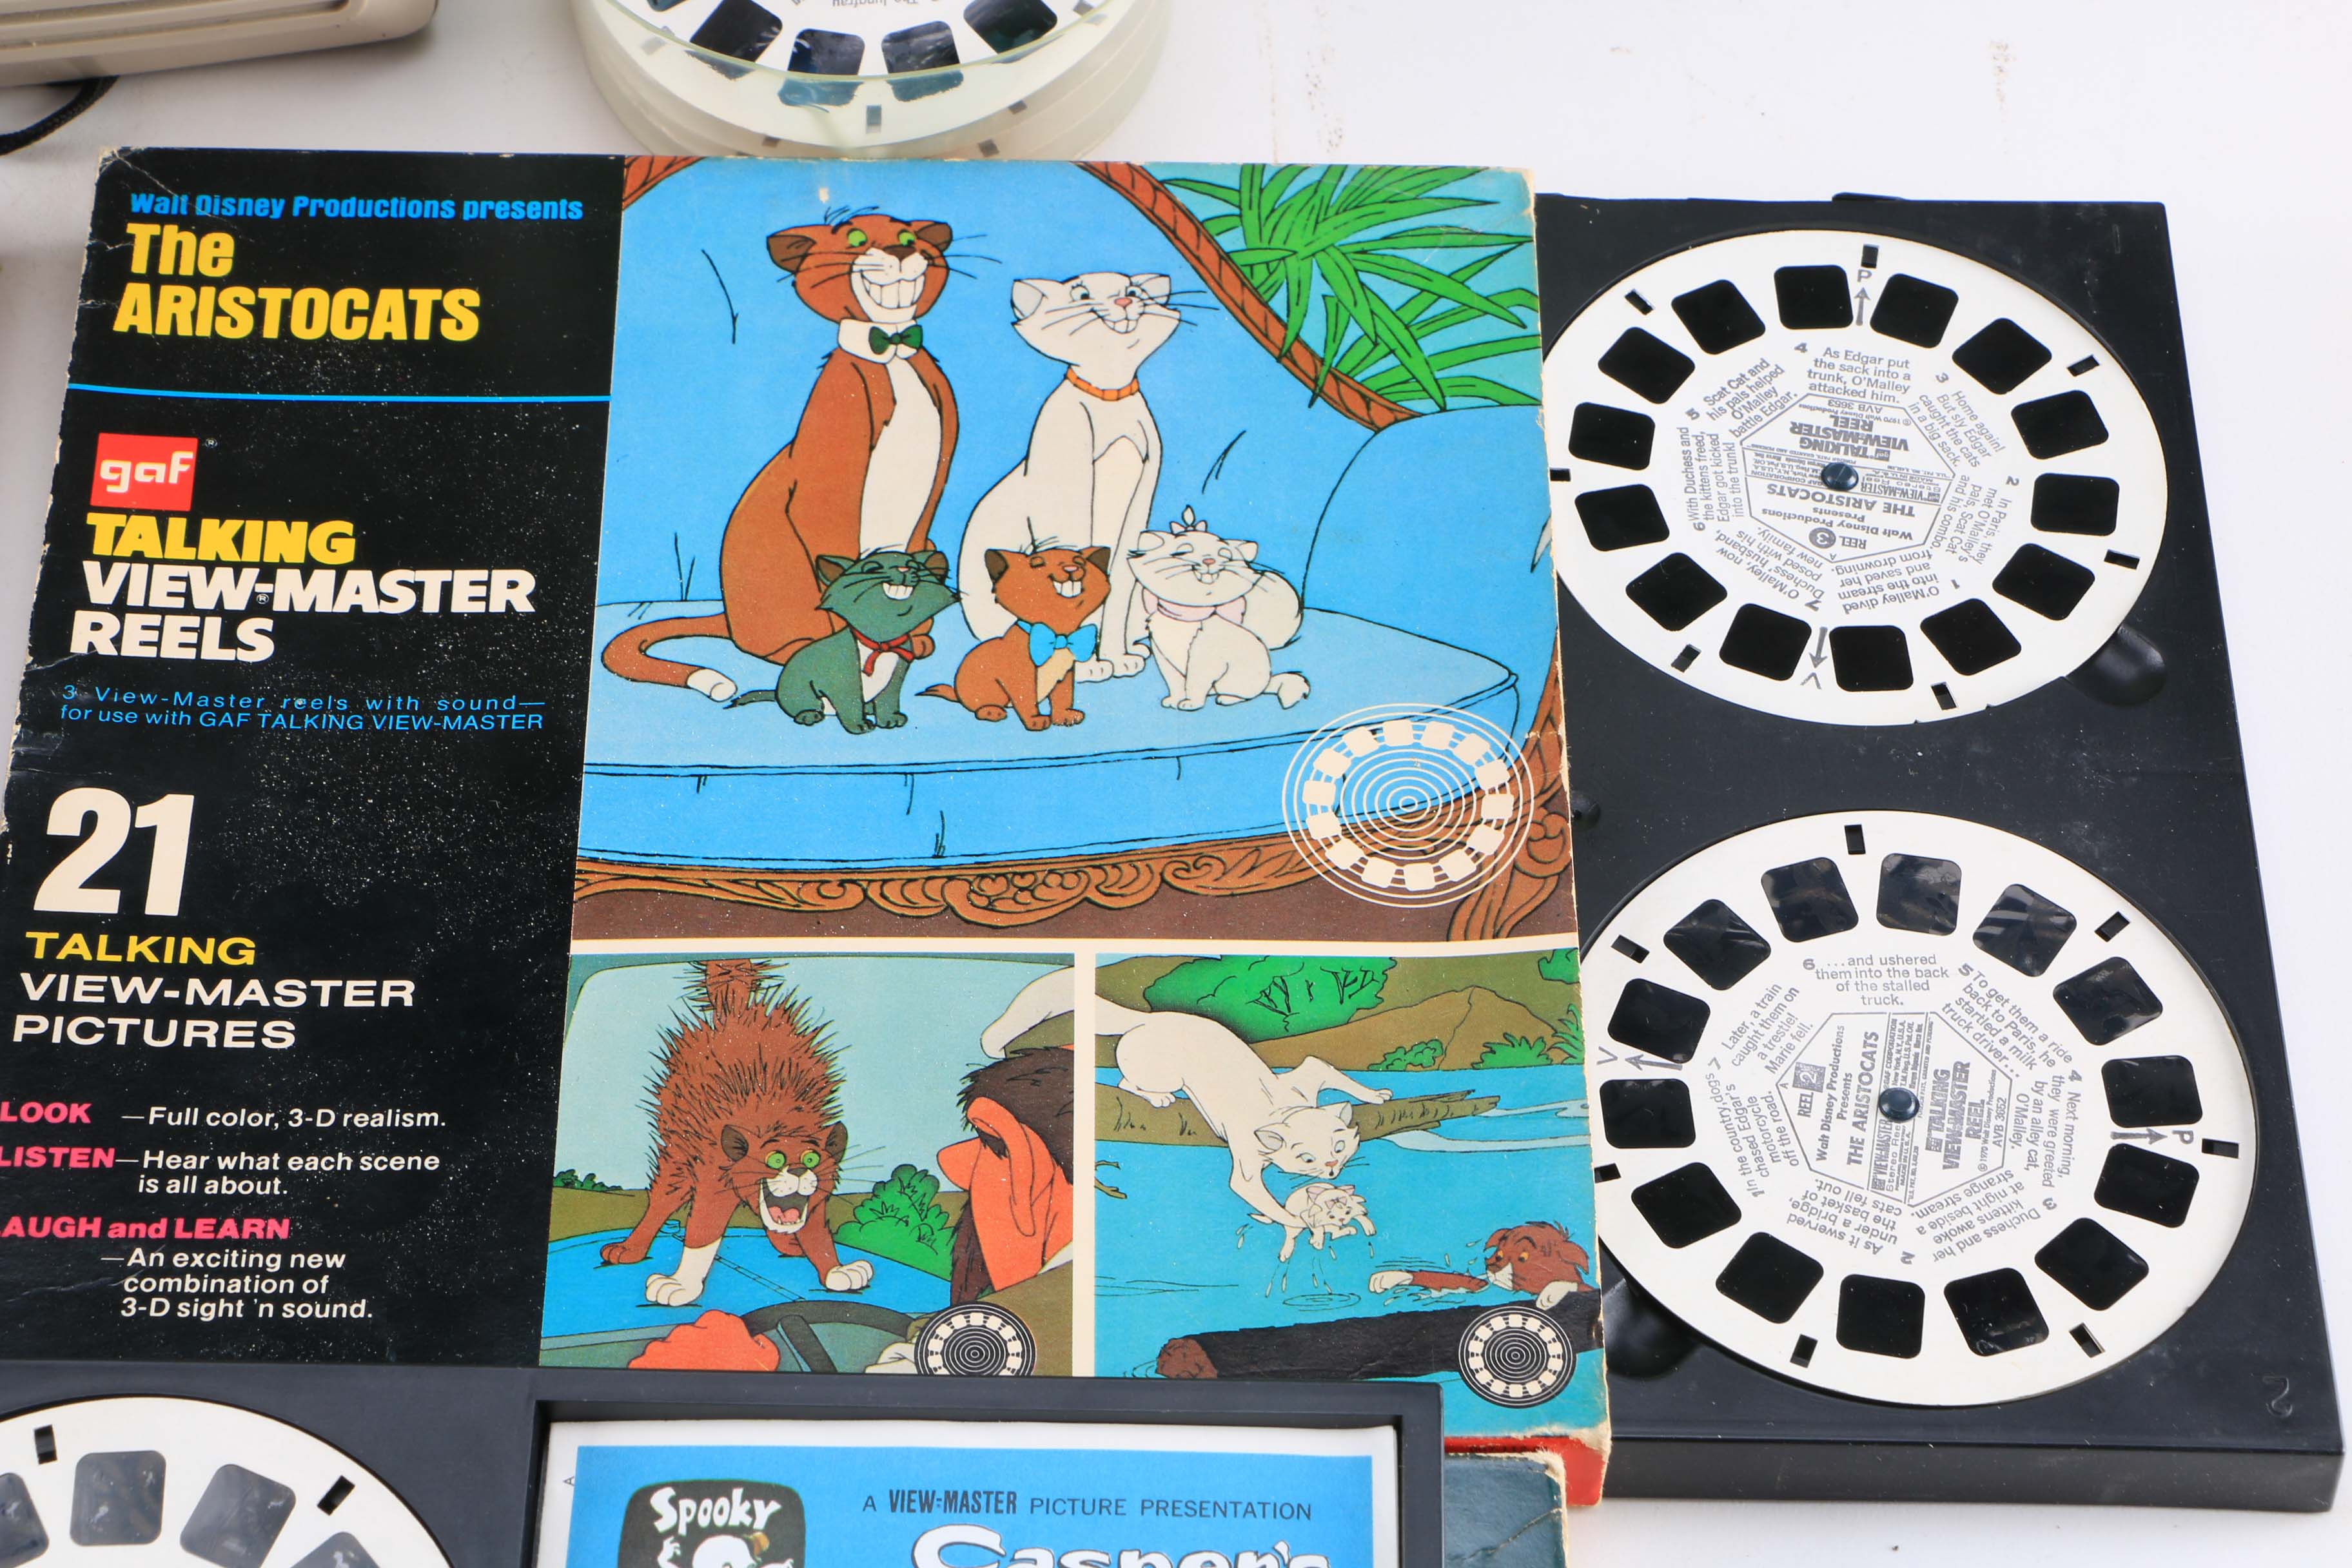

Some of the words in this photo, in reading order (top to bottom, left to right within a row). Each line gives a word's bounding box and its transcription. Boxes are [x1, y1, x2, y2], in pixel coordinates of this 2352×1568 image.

[131, 193, 188, 215] Walt
[195, 195, 284, 220] Disney
[293, 196, 456, 220] Productions
[462, 197, 583, 221] presents
[126, 223, 234, 277] The
[1857, 269, 1872, 282] P
[113, 282, 481, 341] ARISTOCATS
[1794, 342, 1808, 353] 4
[1823, 347, 1840, 358] As
[1844, 349, 1884, 365] Edgar
[1888, 358, 1910, 369] put
[1703, 386, 1732, 406] Scat
[1727, 373, 1750, 389] Cat
[1747, 358, 1770, 377] and
[1807, 369, 1847, 385] trunk,
[1852, 375, 1910, 395] O'Malley
[1814, 358, 1836, 370] the
[1839, 363, 1870, 375] sack
[1874, 366, 1899, 379] into
[1936, 372, 1949, 383] 3
[1706, 406, 1727, 421] his
[1725, 390, 1750, 409] pals
[1746, 364, 1785, 393] helped
[1731, 386, 1778, 420] O'Malley
[1808, 382, 1867, 398] attacked
[1871, 390, 1900, 404] him.
[1828, 399, 1855, 409] 3653
[1685, 407, 1700, 420] 5
[1729, 414, 1763, 438] battle
[1759, 391, 1798, 416] Edgar.
[1858, 404, 1883, 414] AVB
[1951, 390, 1978, 421] Home
[1975, 422, 2006, 452] again!
[1789, 421, 1910, 451] VIEW-MASTER
[1829, 414, 1874, 432] REEL
[1908, 402, 1921, 414] in
[1917, 415, 1927, 423] a
[1924, 422, 1941, 441] big
[1938, 440, 1961, 467] sack.
[1919, 395, 1951, 429] caught
[1945, 427, 1963, 446] the
[1959, 446, 1980, 467] cats
[1937, 393, 1957, 413] But
[1951, 413, 1968, 428] sly
[1963, 428, 1992, 458] Edgar
[1799, 436, 1872, 460] TALKING
[99, 451, 194, 493] gaf
[1767, 483, 1878, 511] ARISTOCATS
[1883, 502, 1916, 517] THE
[1761, 507, 1834, 528] Productions
[1812, 506, 1865, 523] Presents
[1837, 519, 1879, 536] Disney
[86, 513, 355, 565] TALKING
[1839, 535, 1867, 549] REEL
[1882, 527, 1914, 541] Walt
[69, 610, 275, 663] REELS
[62, 685, 76, 700] 3
[95, 687, 264, 710] View-Master
[281, 694, 349, 712] reels
[365, 695, 420, 712] with
[60, 704, 88, 723] for
[97, 709, 131, 725] use
[134, 707, 193, 727] with
[199, 710, 251, 729] GAF
[257, 712, 365, 731] TALKING
[372, 714, 544, 731] VIEW-MASTER
[33, 787, 195, 917] 21
[24, 931, 257, 965] TALKING
[1879, 954, 1937, 966] ushered
[1803, 958, 1816, 970] 6
[1816, 968, 1852, 980] them
[1855, 967, 1883, 979] into
[1886, 967, 1910, 978] the
[1915, 966, 1950, 978] back
[1958, 963, 1974, 976] 5
[19, 972, 416, 1008] VIEW-MASTER
[1836, 980, 1850, 992] of
[1854, 980, 1878, 992] the
[1882, 979, 1930, 991] stalled
[1861, 994, 1904, 1006] truck.
[1941, 1003, 1975, 1034] truck
[1963, 983, 1992, 1012] back
[1991, 1008, 2005, 1023] to
[2004, 1021, 2037, 1054] Paris,
[2039, 1050, 2055, 1068] he
[1972, 970, 1988, 988] To
[1986, 988, 2010, 1007] get
[2008, 1004, 2039, 1034] them
[2039, 1033, 2048, 1042] a
[2048, 1041, 2073, 1063] ride
[12, 1014, 296, 1050] PICTURES
[1955, 996, 2002, 1037] startled
[1999, 1036, 2009, 1046] a
[2008, 1045, 2037, 1070] milk
[1826, 1025, 1845, 1092] Productions
[1852, 1031, 1879, 1132] ARISTOCATS
[2031, 1080, 2048, 1096] by
[2048, 1075, 2065, 1102] they
[2068, 1070, 2082, 1082] 4
[1798, 1092, 1814, 1118] REEL
[1836, 1072, 1852, 1121] Presents
[1995, 1097, 2007, 1122] 3652
[2032, 1098, 2043, 1113] an
[2066, 1092, 2081, 1121] Next
[0, 1101, 92, 1124] LOOK
[206, 1108, 279, 1132] color,
[288, 1109, 336, 1127] 3-D
[342, 1108, 447, 1128] realism.
[1820, 1094, 1838, 1133] Disney
[2009, 1093, 2030, 1150] O'Malley.
[2047, 1109, 2059, 1137] were
[1992, 1125, 2005, 1148] AVB
[2026, 1117, 2044, 1147] alley
[2171, 1130, 2194, 1144] P
[1816, 1133, 1829, 1162] Walt
[1847, 1136, 1865, 1165] THE
[2024, 1149, 2040, 1171] cat,
[2057, 1124, 2075, 1178] morning,
[217, 1153, 280, 1170] what
[287, 1153, 352, 1171] each
[358, 1154, 440, 1171] scene
[2042, 1141, 2057, 1188] greeted
[138, 1175, 159, 1194] is
[166, 1175, 197, 1195] all
[204, 1175, 289, 1195] about.
[0, 1217, 101, 1239] AUGH
[107, 1217, 168, 1239] and
[173, 1218, 291, 1239] LEARN
[172, 1248, 282, 1272] exciting
[289, 1253, 347, 1268] new
[123, 1273, 295, 1295] combination
[302, 1274, 330, 1295] of
[121, 1298, 170, 1318] 3-D
[177, 1298, 244, 1322] sight
[281, 1298, 373, 1319] sound.
[650, 1487, 783, 1536] Spooky
[862, 1495, 877, 1512] A
[888, 1489, 1017, 1514] VIEW-MASTER
[1030, 1497, 1127, 1516] PICTURE
[1141, 1499, 1312, 1521] PRESENTATION
